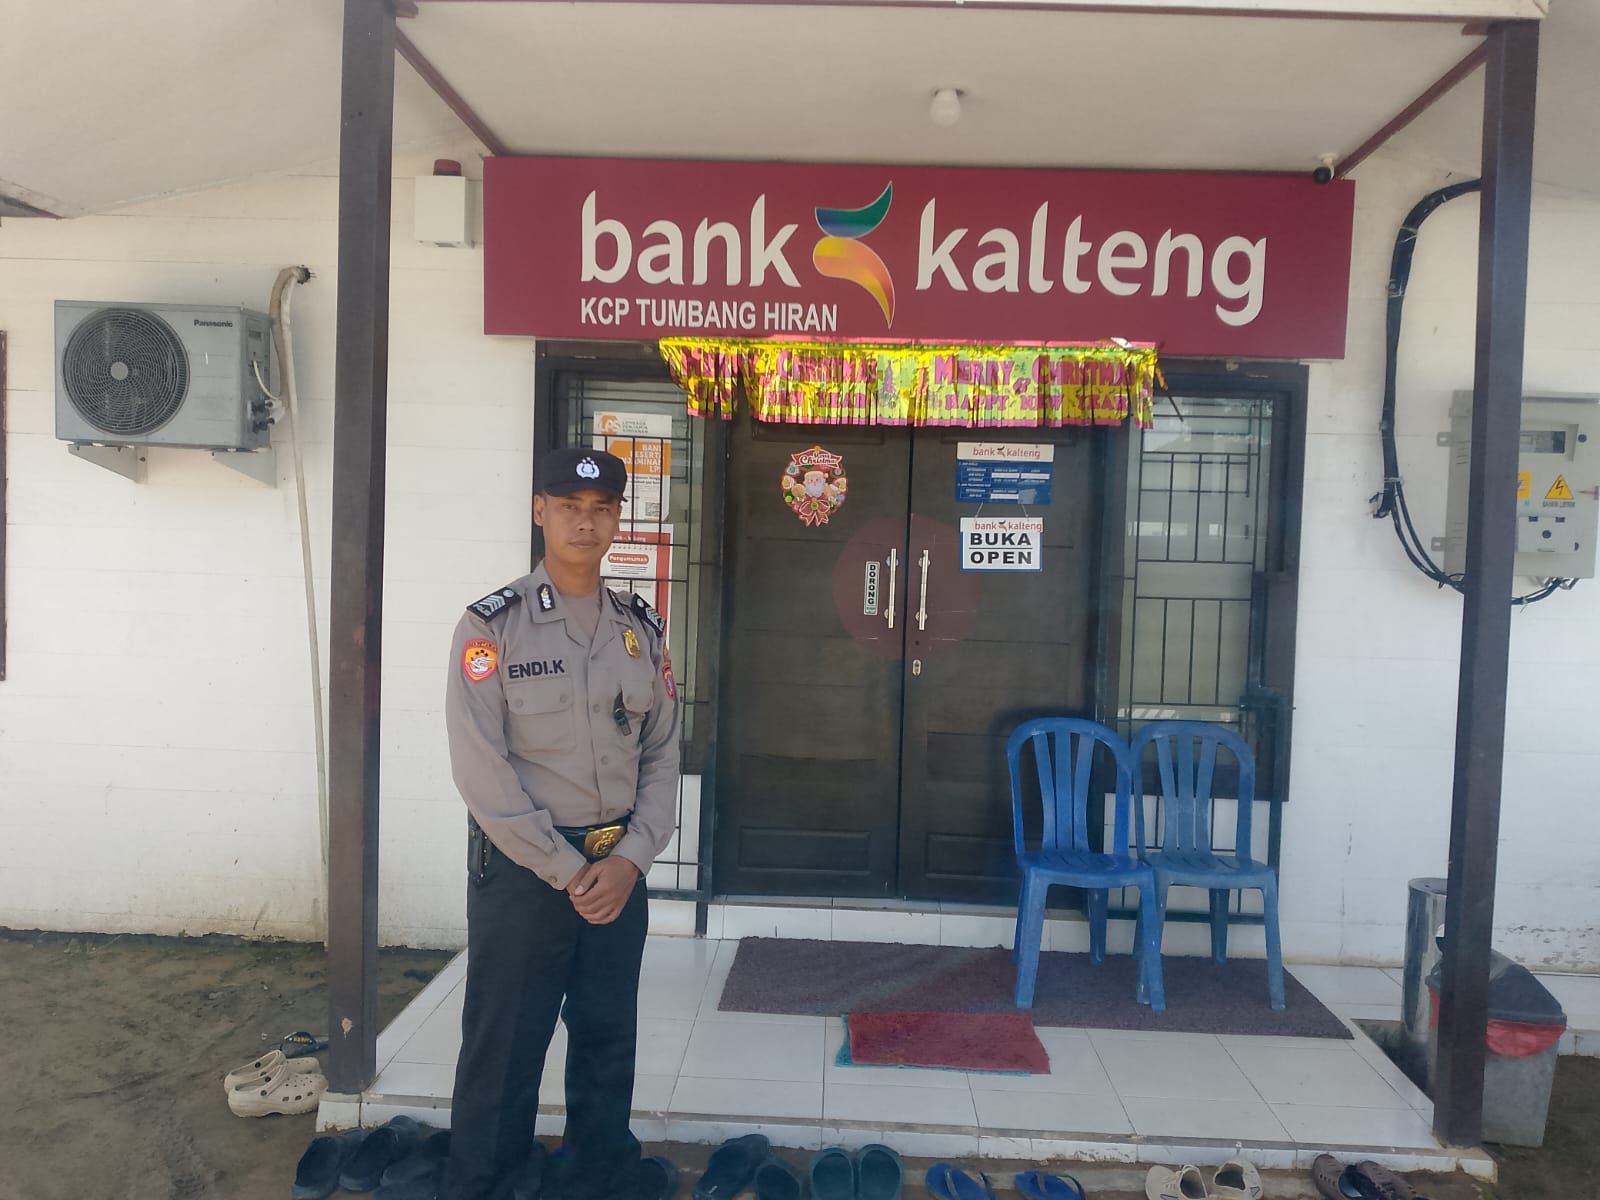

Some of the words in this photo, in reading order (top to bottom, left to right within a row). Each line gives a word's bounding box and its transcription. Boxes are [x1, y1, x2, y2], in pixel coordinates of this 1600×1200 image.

[580, 190, 801, 288] bank
[915, 197, 1267, 326] kalteng
[581, 296, 630, 325] KCP
[636, 298, 756, 330] TUMBANG
[764, 303, 838, 332] HIRAN
[193, 319, 233, 328] Panasonic
[934, 354, 1014, 385] MERRY
[945, 394, 1008, 411] HAPPY
[1021, 394, 1064, 411] NEW
[973, 447, 995, 456] bank
[1006, 448, 1040, 460] kalteng
[975, 521, 997, 530] bank
[1008, 521, 1042, 532] kalteng
[970, 532, 1032, 545] BUKA
[970, 551, 1032, 564] OPEN
[867, 564, 876, 605] DORONG
[507, 659, 565, 679] ENDI.K
